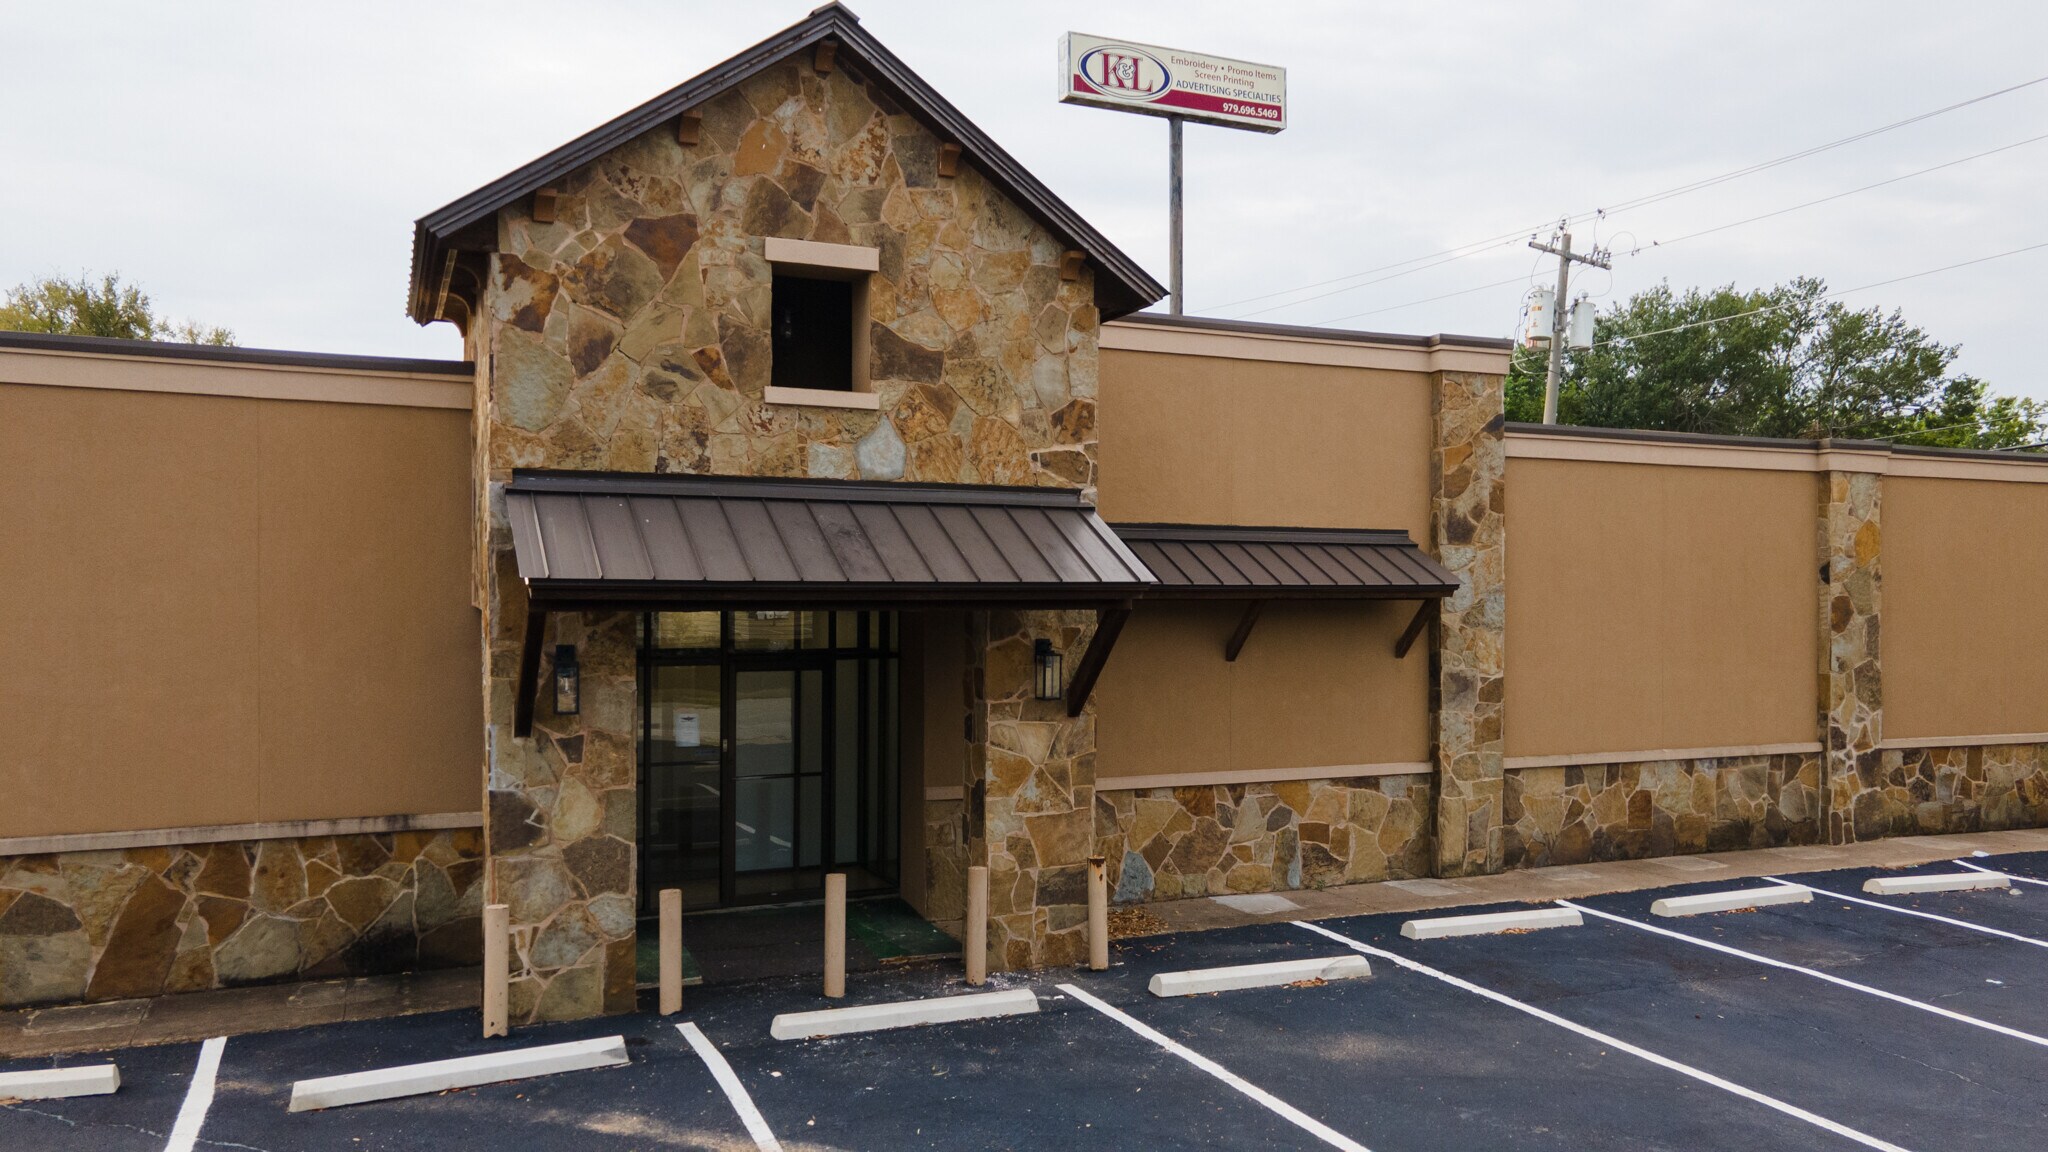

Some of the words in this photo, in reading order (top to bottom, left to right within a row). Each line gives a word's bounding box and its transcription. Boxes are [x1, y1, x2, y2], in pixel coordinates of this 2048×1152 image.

[1171, 55, 1218, 73] Embroidery
[1227, 65, 1254, 77] Promo
[1255, 70, 1277, 81] Items
[1194, 69, 1221, 81] Screen
[1223, 74, 1255, 89] Printing
[1176, 79, 1231, 96] ADVERTISING
[1232, 88, 1282, 103] SPECIALTIES
[1222, 102, 1278, 119] 979.696.5469
